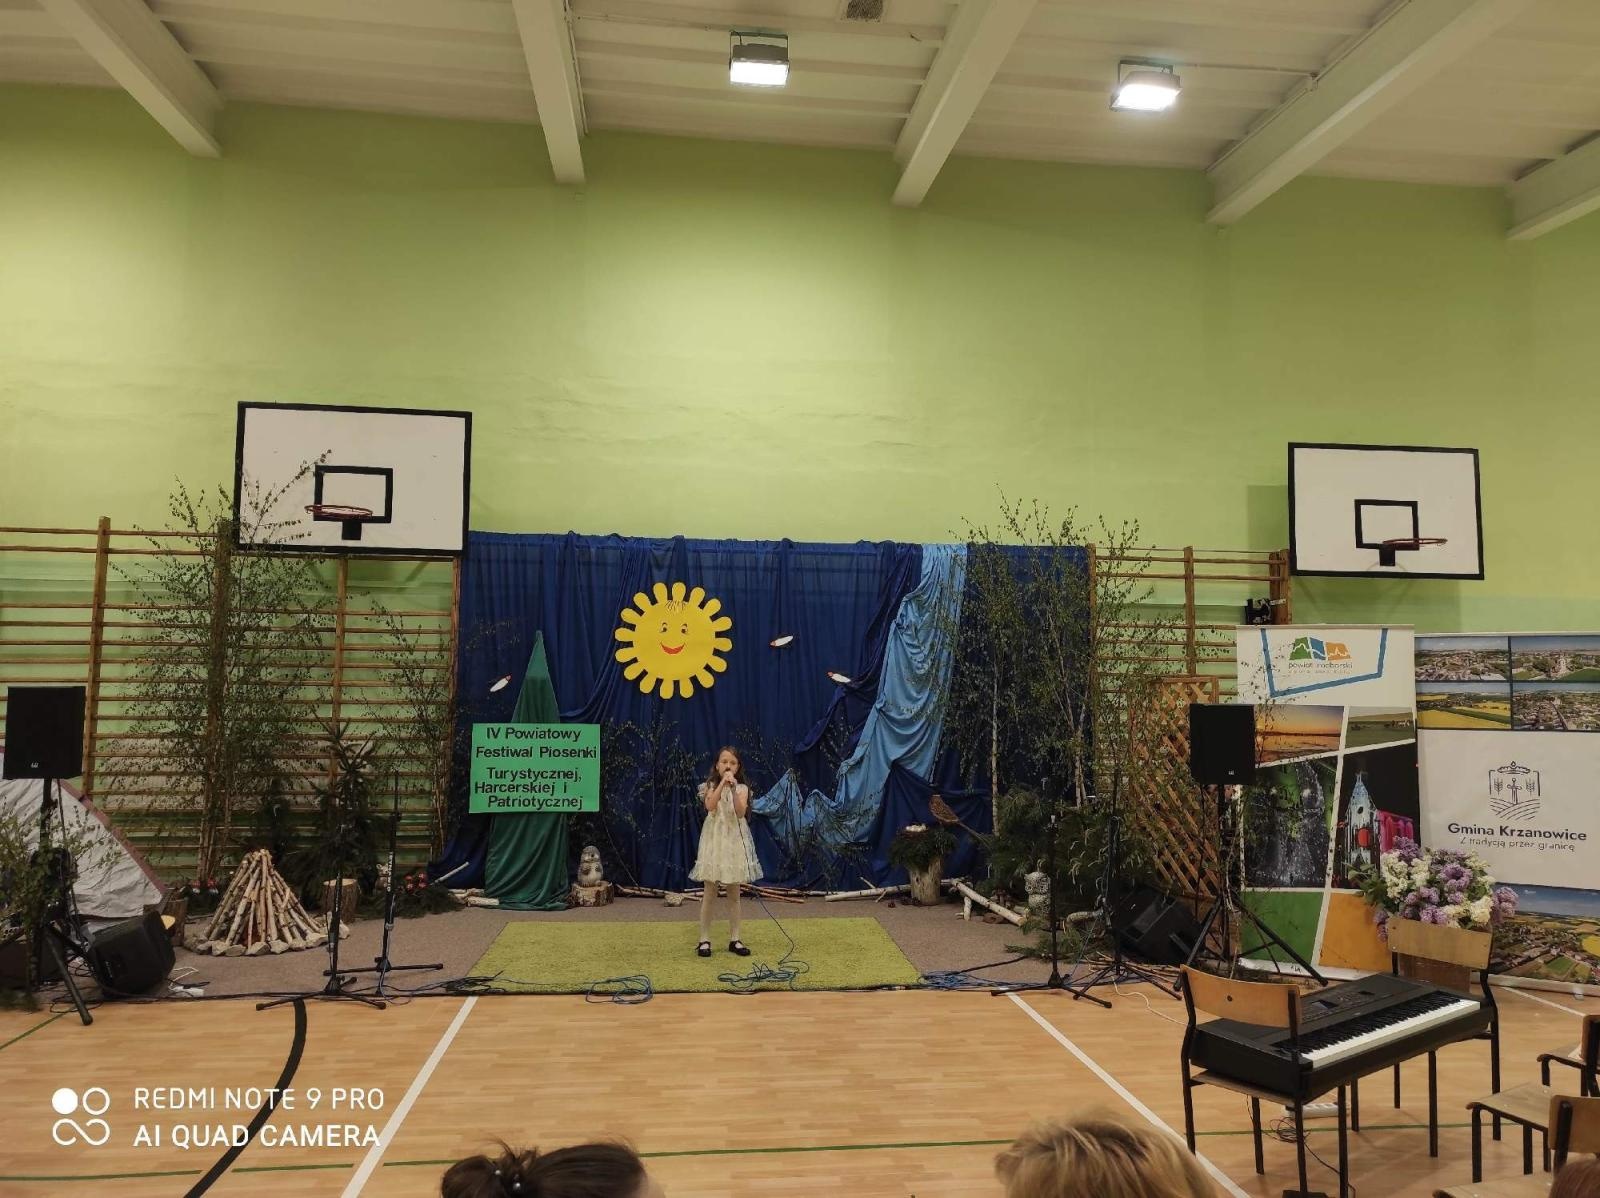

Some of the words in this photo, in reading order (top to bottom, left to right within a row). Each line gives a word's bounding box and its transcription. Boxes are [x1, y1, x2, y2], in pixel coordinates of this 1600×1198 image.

[486, 727, 501, 740] IV
[505, 727, 582, 743] Powiatowy
[475, 746, 533, 759] Festiwal
[539, 746, 597, 759] Piosenki
[486, 767, 582, 783] Turystycznej,
[474, 781, 556, 797] Harcerskiej
[563, 781, 568, 794] i
[487, 795, 583, 811] Patriotycznej
[1447, 822, 1495, 836] Gmina
[1499, 825, 1587, 841] Krzanowice
